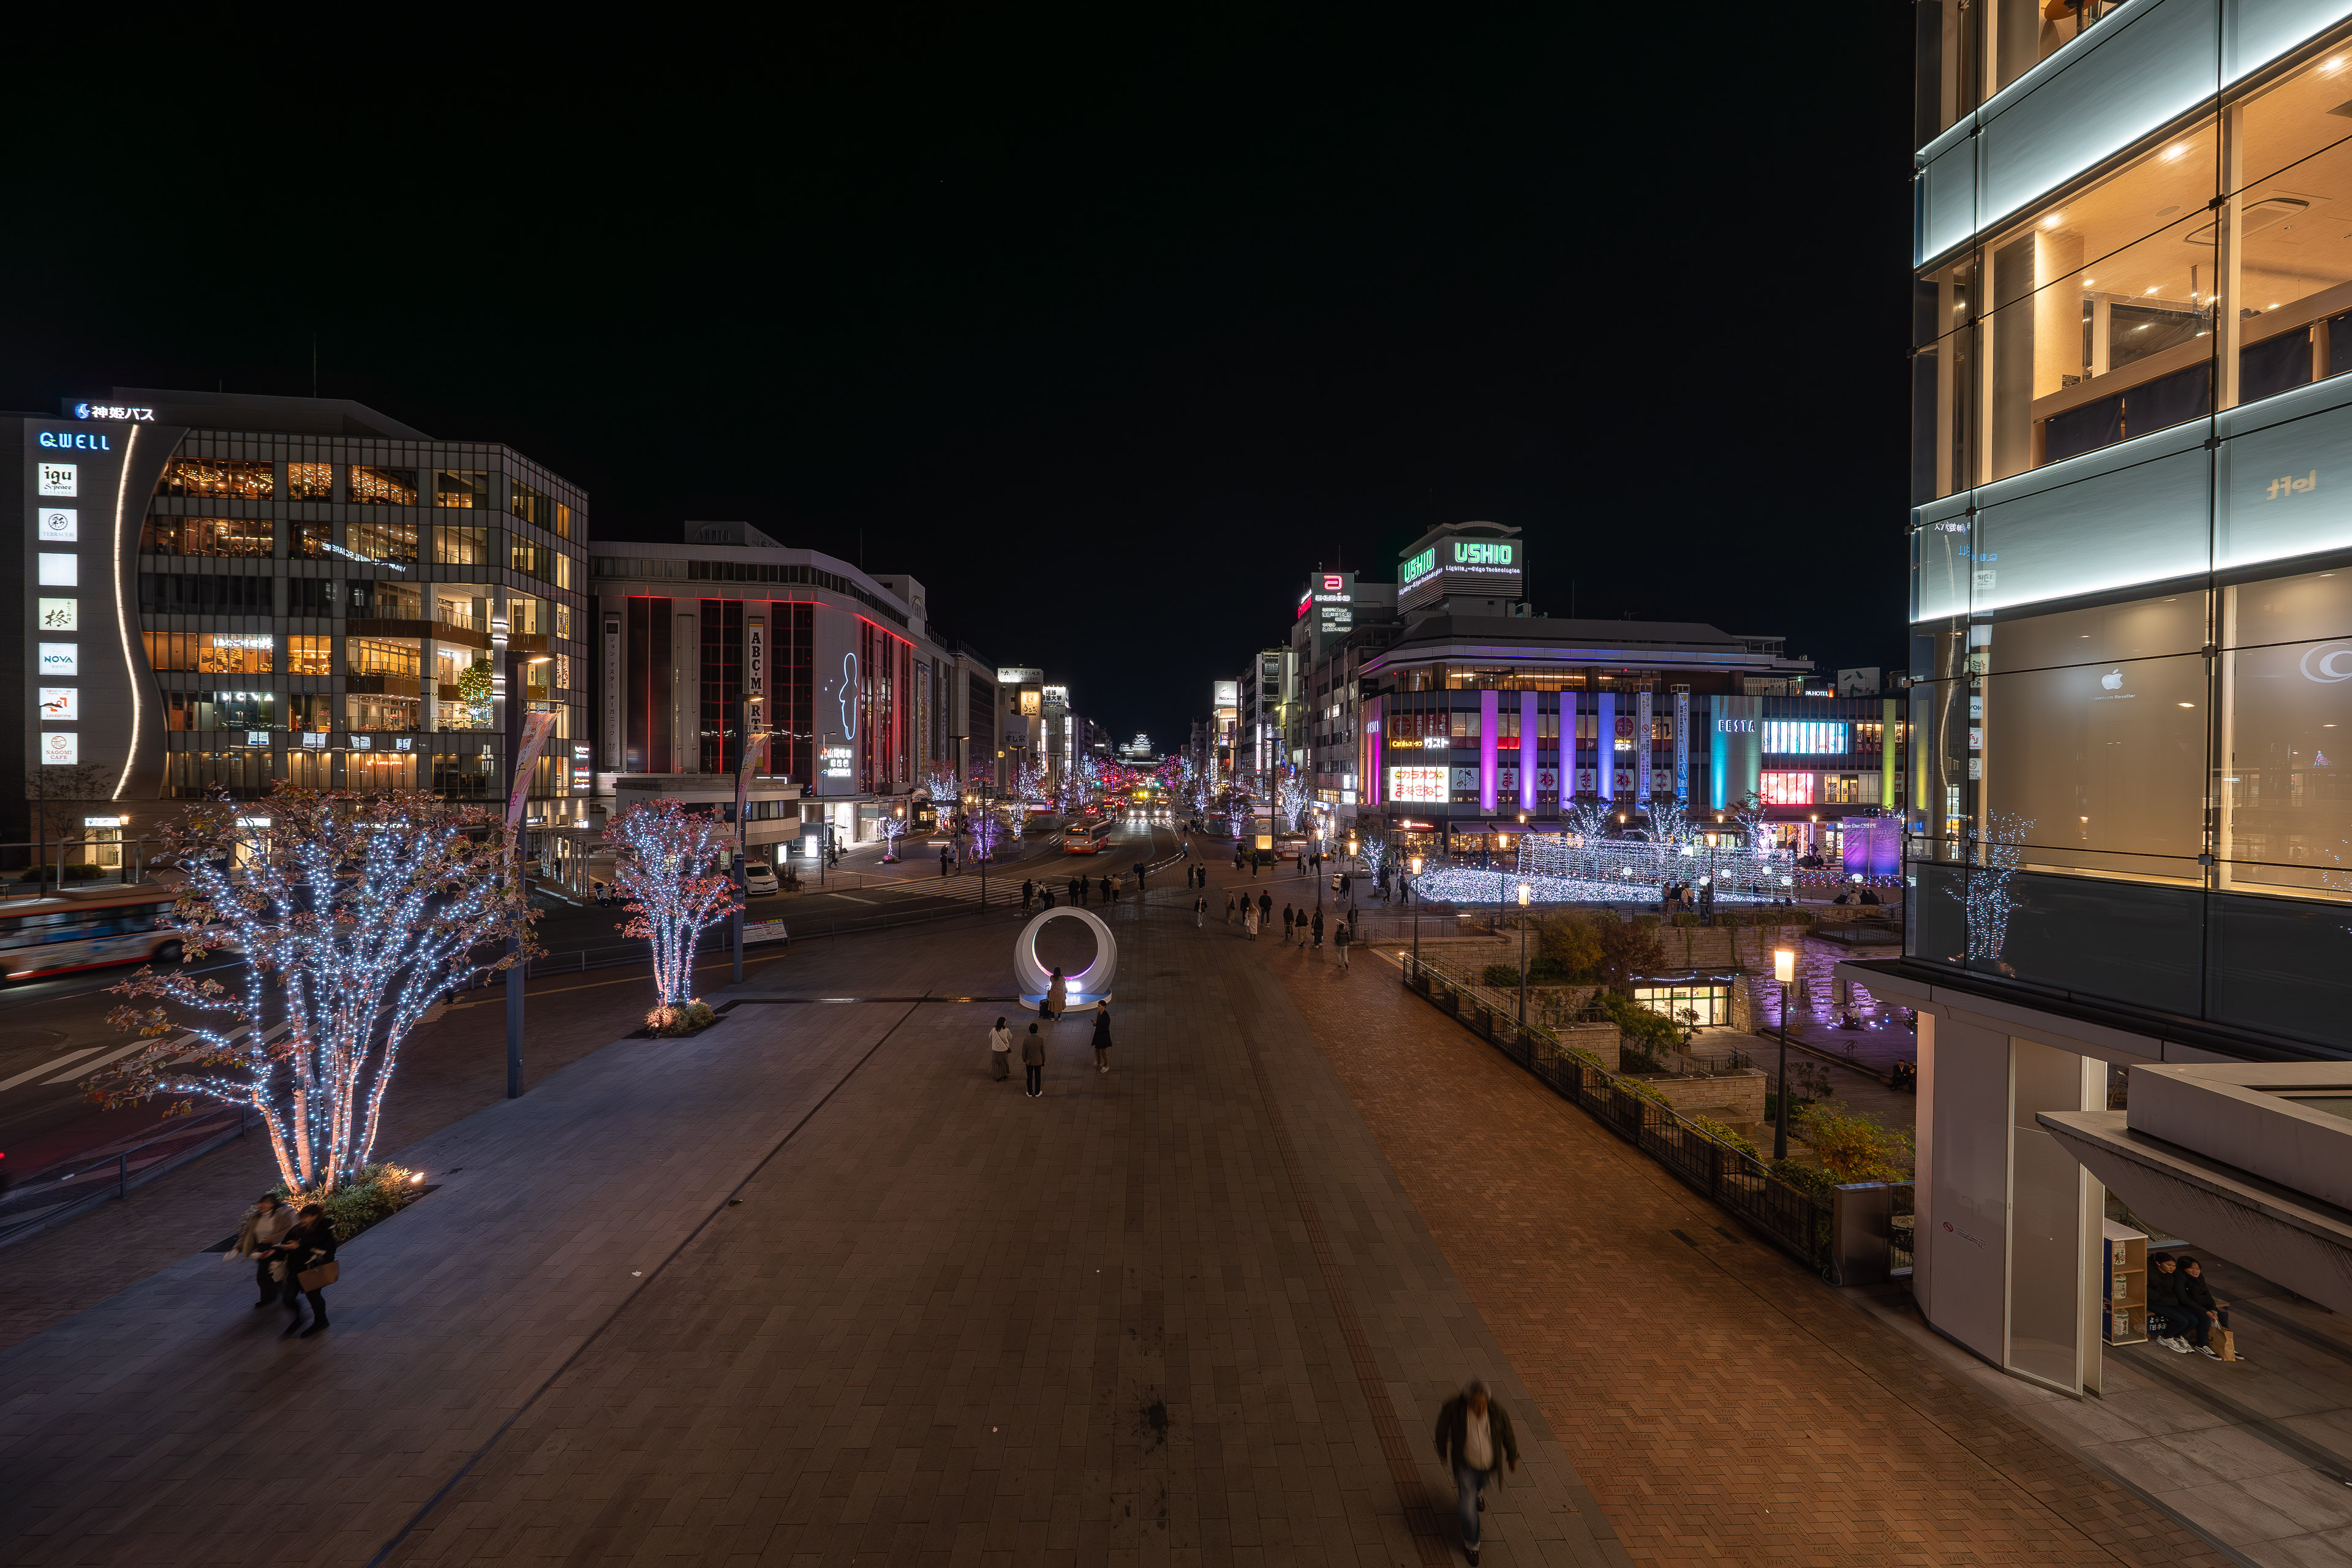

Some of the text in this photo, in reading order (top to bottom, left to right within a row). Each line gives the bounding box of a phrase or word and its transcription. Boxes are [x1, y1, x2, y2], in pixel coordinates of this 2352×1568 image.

[91, 406, 155, 421] 神姫バス
[40, 432, 110, 450] QWELL
[44, 466, 72, 485] igu
[1455, 543, 1512, 564] USHIO
[1404, 548, 1435, 583] USHIO
[751, 632, 761, 730] ABC-MRT
[1718, 719, 1755, 732] FESTA
[1401, 771, 1437, 779] カラオケ
[1395, 784, 1444, 797] まねきねこ
